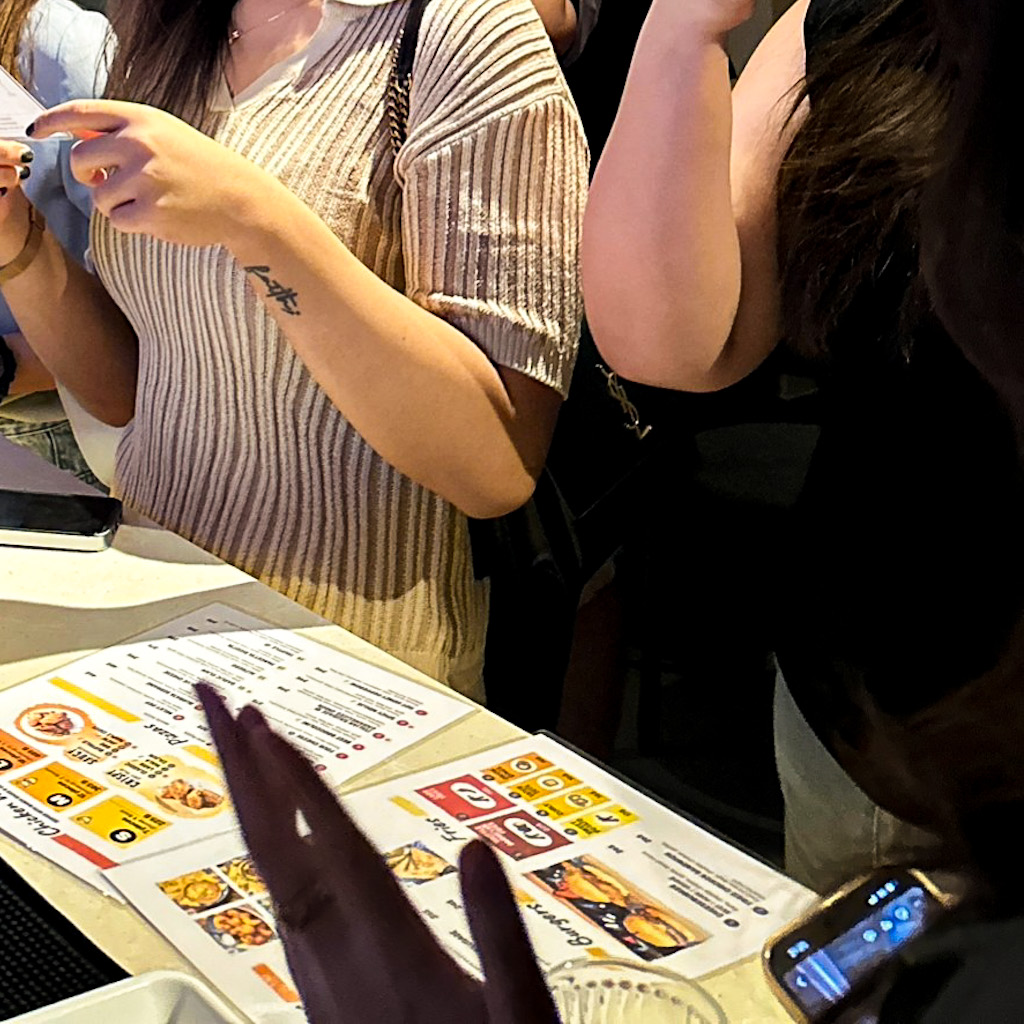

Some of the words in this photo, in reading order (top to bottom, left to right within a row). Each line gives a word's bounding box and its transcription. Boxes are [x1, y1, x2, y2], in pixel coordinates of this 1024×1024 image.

[143, 724, 189, 746] Pizzas
[107, 769, 141, 788] CRISPY
[50, 794, 70, 806] M
[7, 802, 61, 836] Chicken
[426, 818, 466, 842] Fries
[115, 831, 132, 841] S
[526, 903, 593, 946] Burgers
